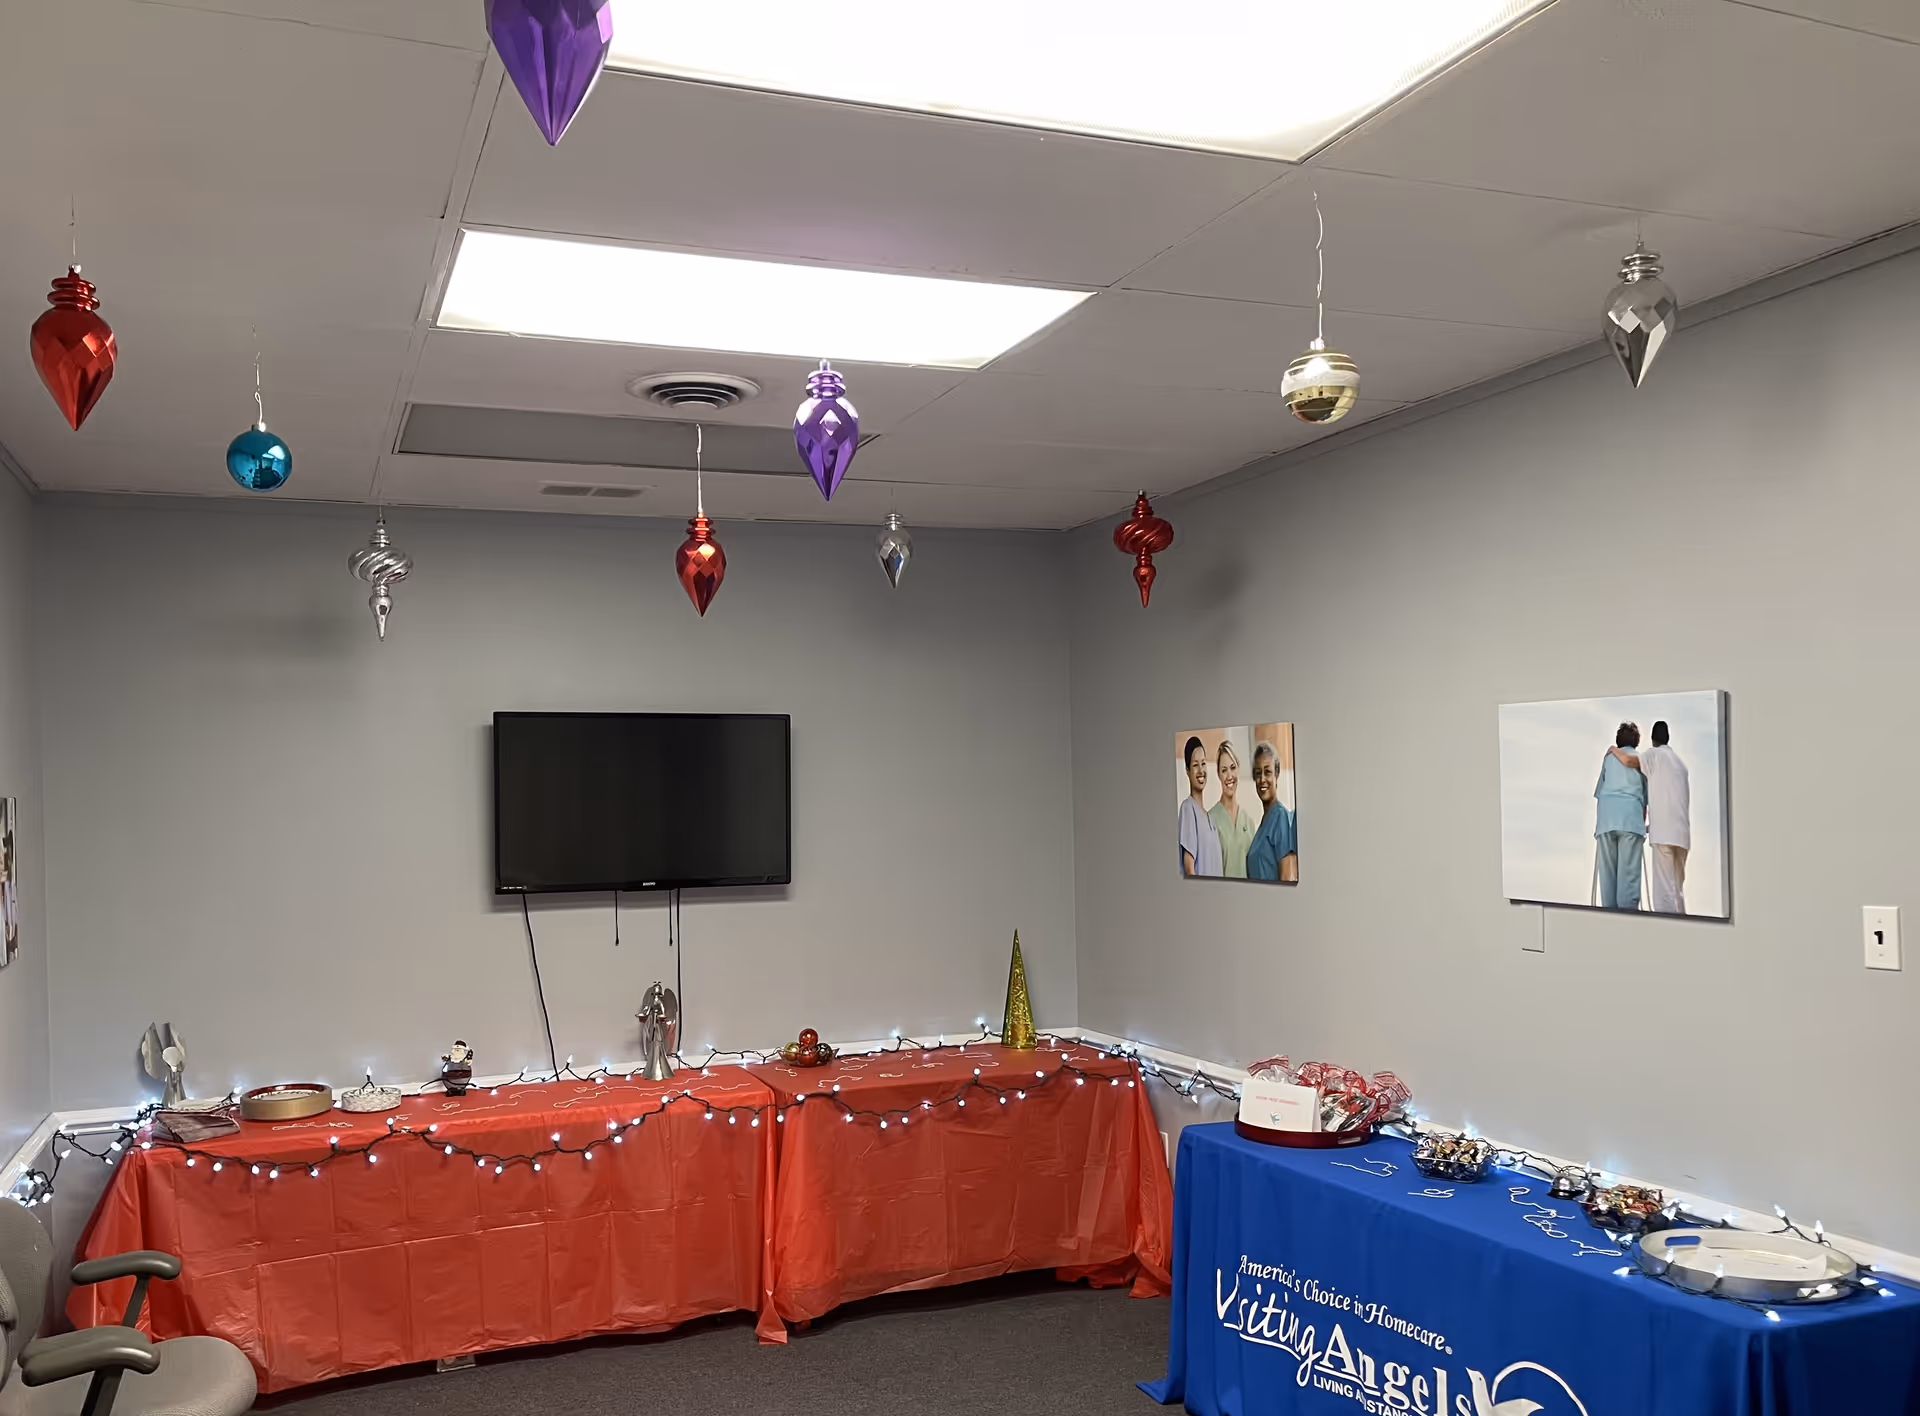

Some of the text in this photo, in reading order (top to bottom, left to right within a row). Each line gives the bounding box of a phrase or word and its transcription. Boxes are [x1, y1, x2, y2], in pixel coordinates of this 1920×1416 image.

[1238, 1254, 1301, 1293] America's
[1303, 1279, 1351, 1311] Choice
[1353, 1294, 1364, 1319] in
[1313, 1373, 1354, 1398] LIVING
